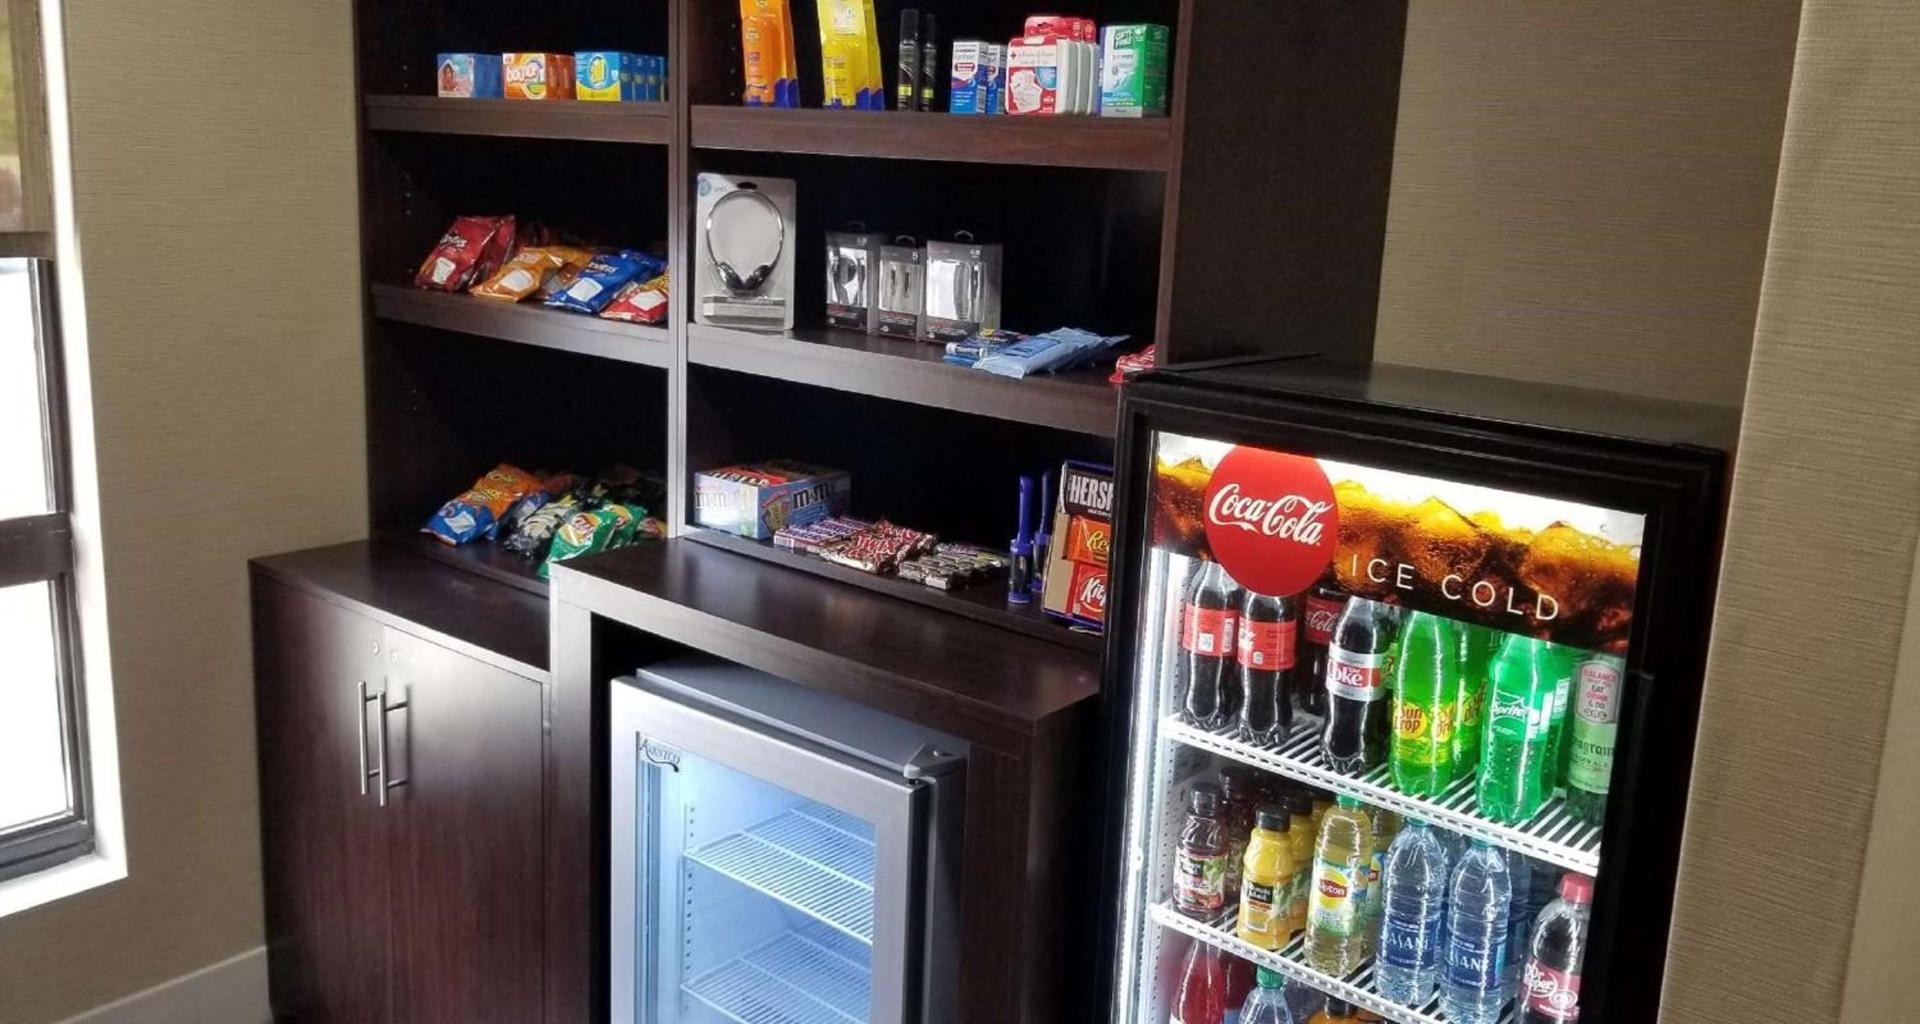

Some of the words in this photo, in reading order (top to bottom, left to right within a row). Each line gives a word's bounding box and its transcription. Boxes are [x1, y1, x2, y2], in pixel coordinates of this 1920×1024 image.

[1208, 483, 1335, 546] Coca-Cola
[1351, 554, 1415, 590] ICE
[1441, 574, 1559, 621] COLD
